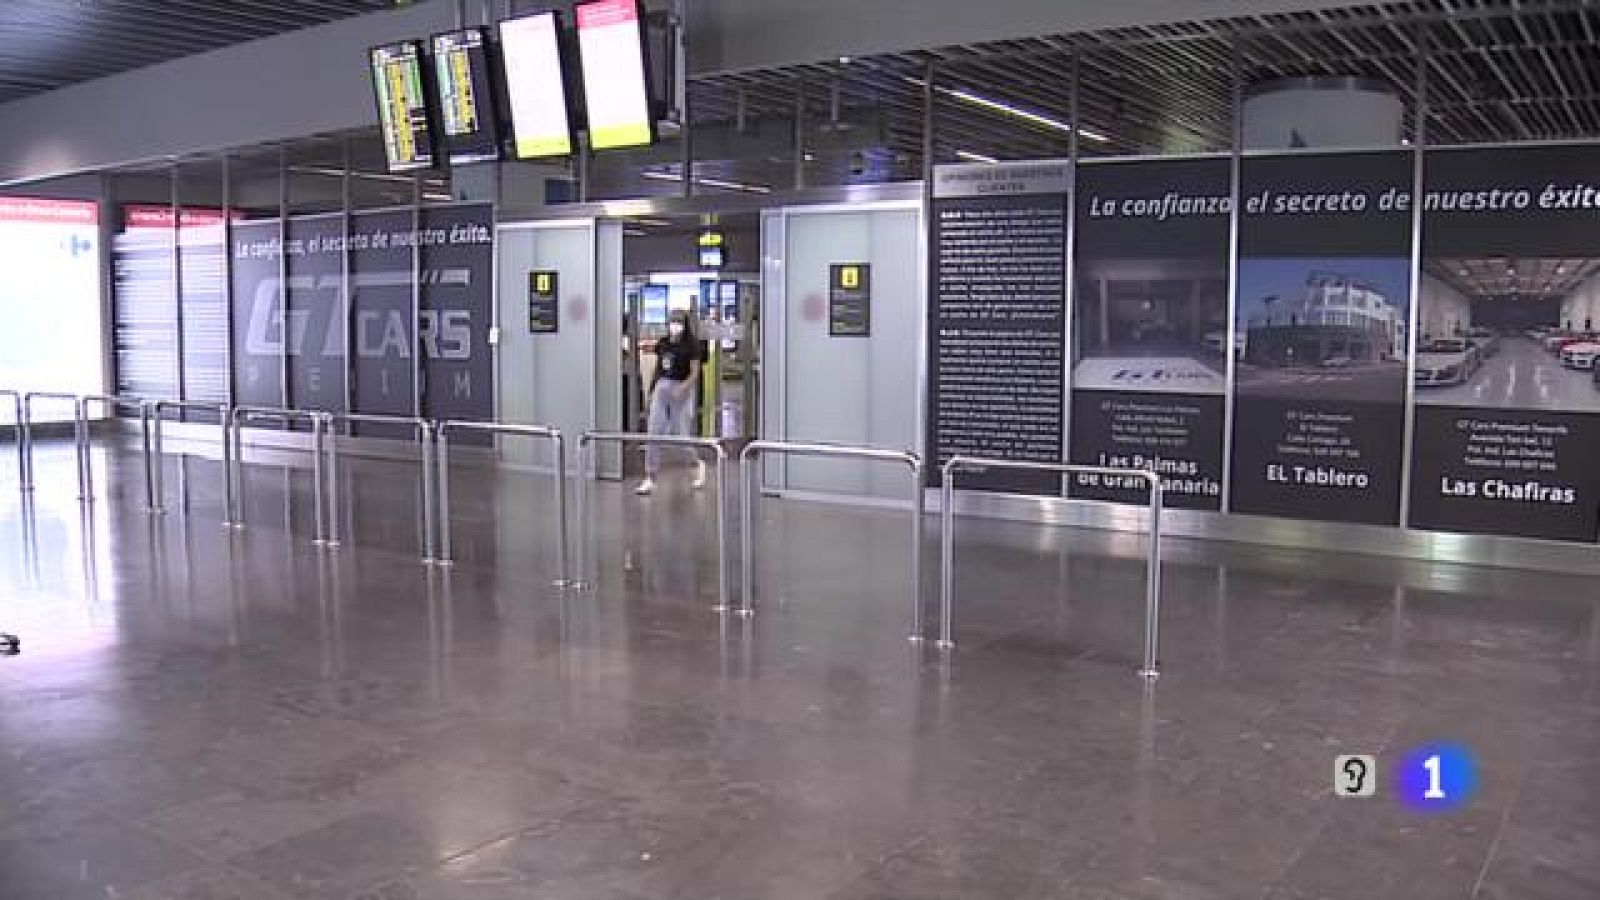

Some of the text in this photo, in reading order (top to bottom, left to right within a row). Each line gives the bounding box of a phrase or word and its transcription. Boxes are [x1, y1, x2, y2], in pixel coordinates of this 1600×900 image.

[1090, 197, 1116, 216] La
[1121, 193, 1233, 221] confianza
[1246, 190, 1269, 213] el
[1274, 192, 1366, 214] secreto
[1379, 187, 1411, 211] de
[1425, 188, 1530, 212] nuestro
[251, 237, 306, 260] confinza,
[322, 233, 369, 252] seceto
[371, 229, 389, 248] de
[357, 308, 471, 358] CARS
[1133, 454, 1198, 476] Palmas
[1293, 466, 1369, 488] Tablero
[1156, 477, 1220, 496] anaria
[1441, 476, 1576, 503] Las Chafiras
